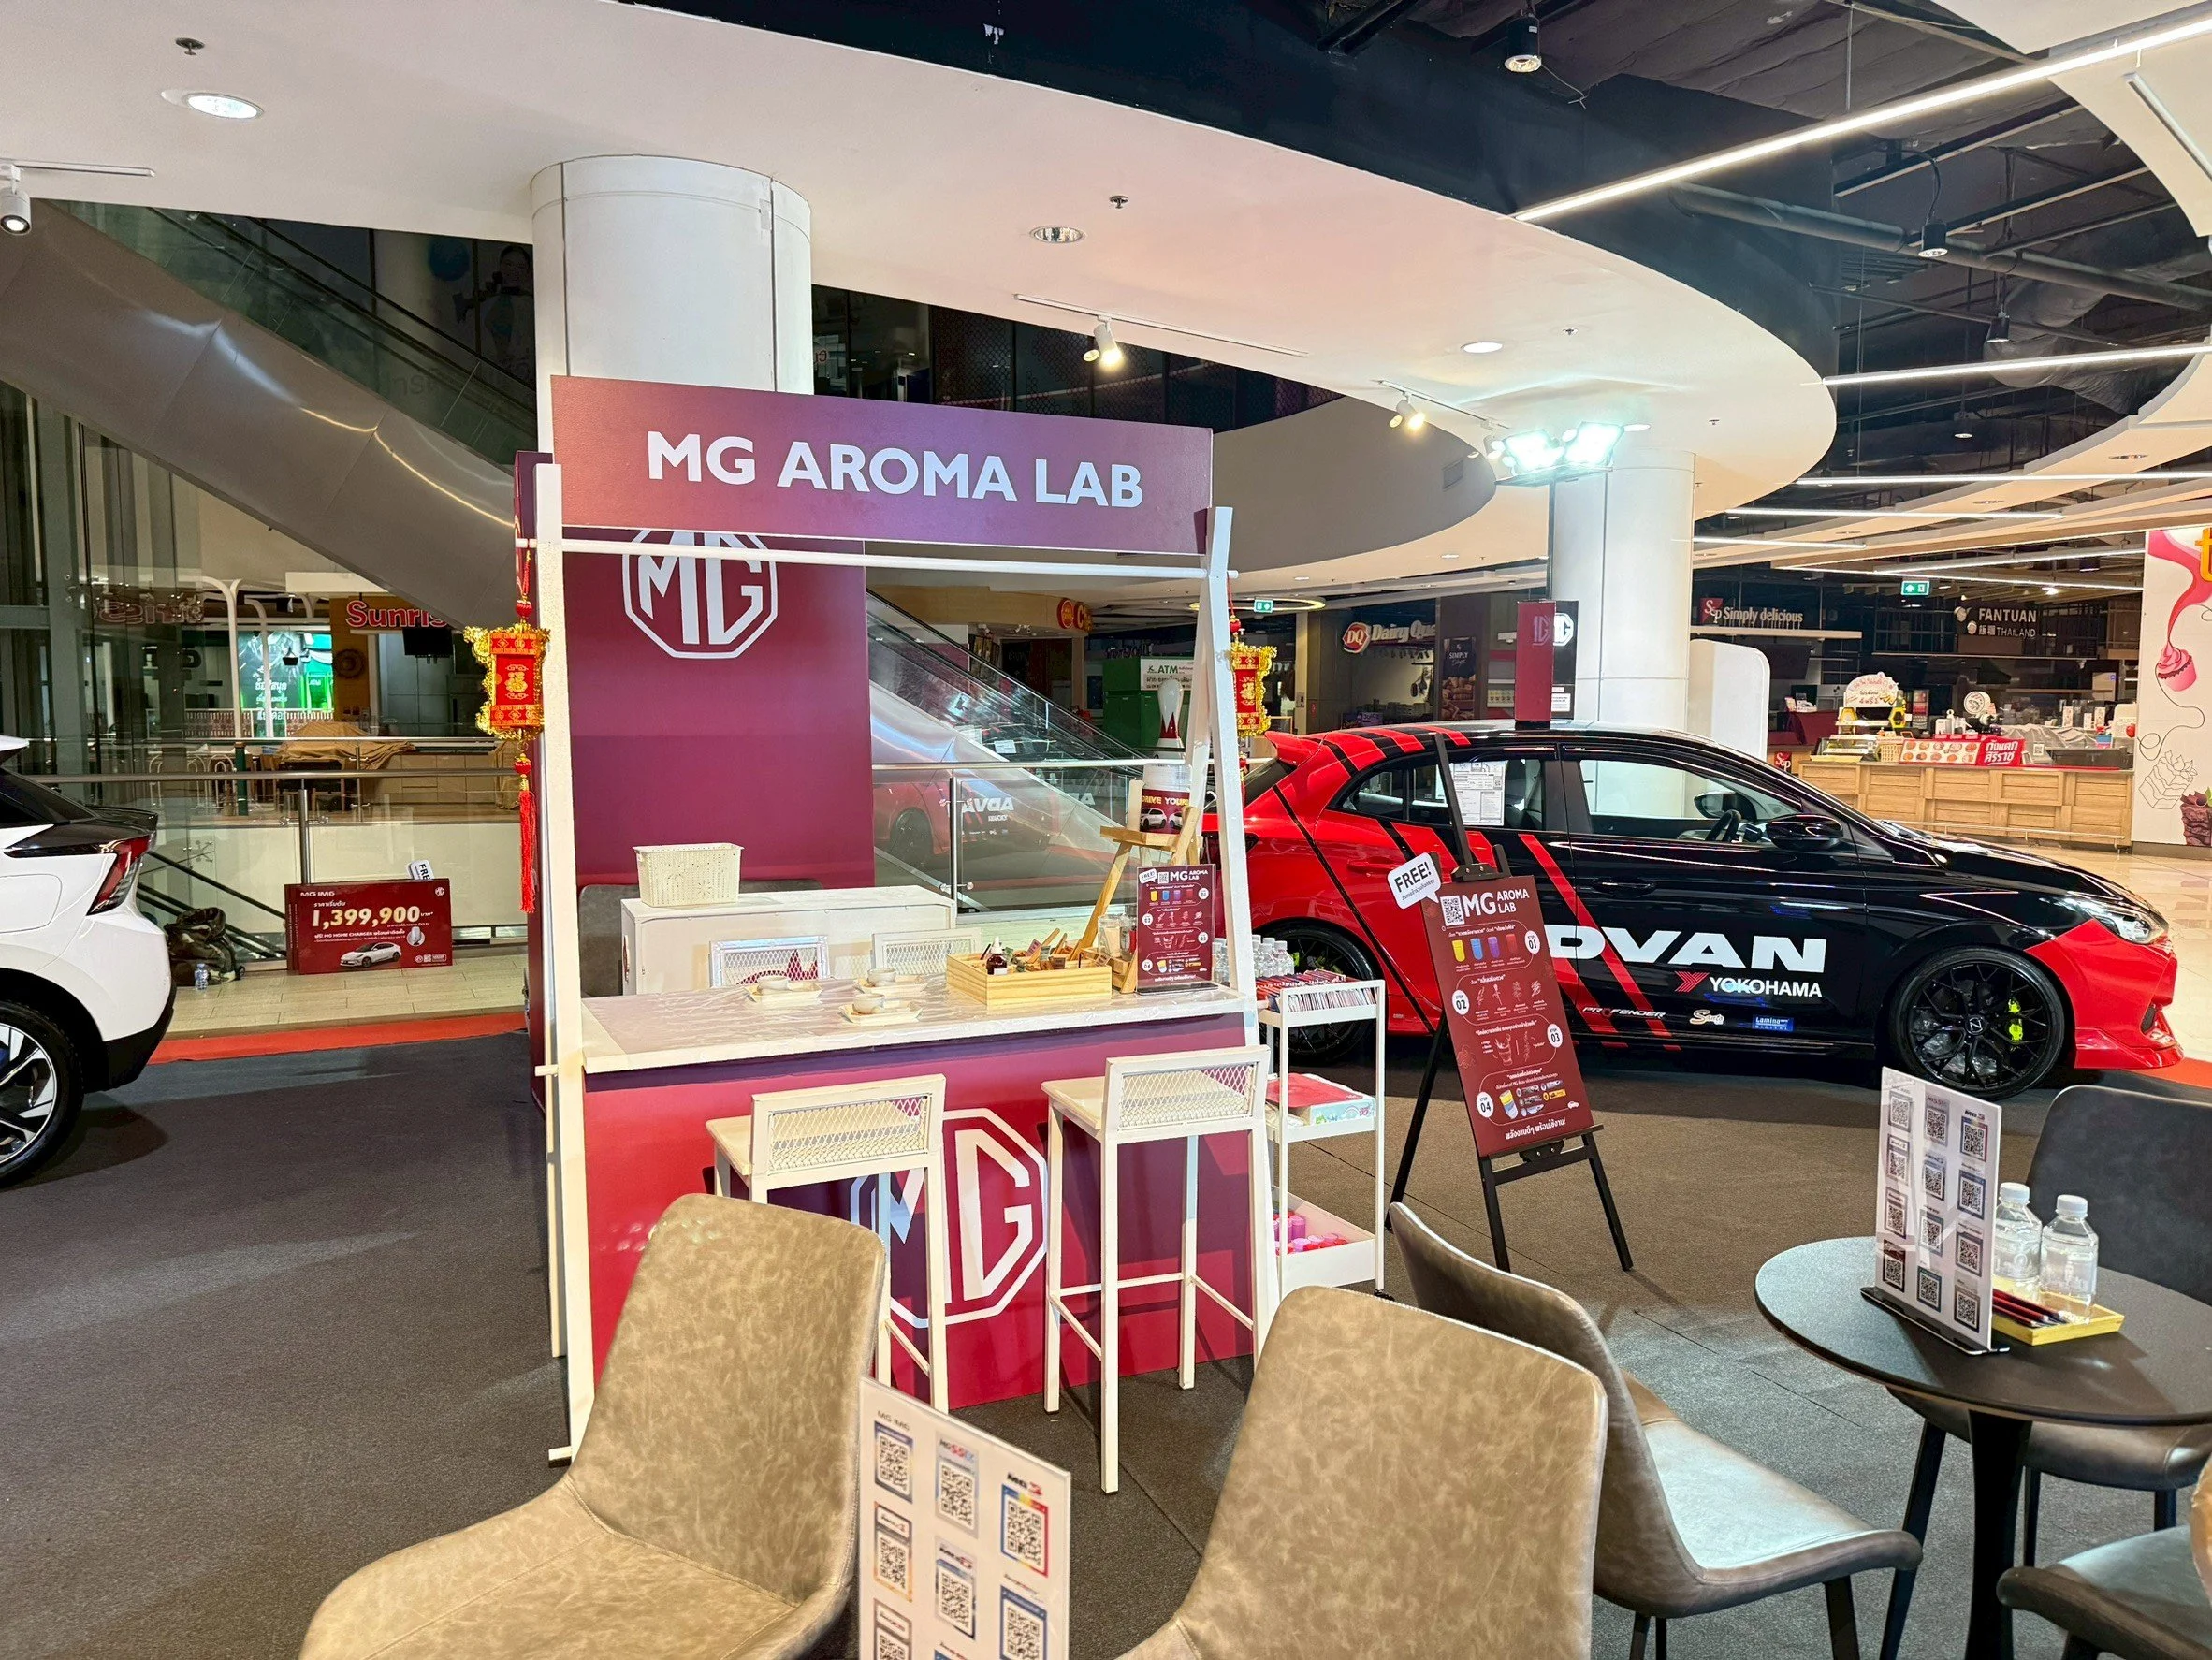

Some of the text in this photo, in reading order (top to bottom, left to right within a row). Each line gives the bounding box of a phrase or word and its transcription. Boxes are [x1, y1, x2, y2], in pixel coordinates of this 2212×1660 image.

[648, 430, 1145, 510] MG AROMA LAB
[1723, 606, 1758, 624] Simply
[1760, 606, 1803, 623] delicious
[1977, 607, 2037, 624] FANTUAN
[1346, 630, 1365, 645] DQ
[1371, 623, 1410, 643] Dairy
[1996, 626, 2036, 638] THAILAND
[1157, 665, 1179, 675] ATM
[1984, 751, 2016, 764] ศิริราช
[1170, 871, 1188, 881] MG
[1394, 861, 1433, 893] FREE!
[1462, 888, 1530, 918] MG AROMA
[1498, 902, 1517, 914] LAB
[312, 906, 420, 930] 1,399,900
[1528, 939, 1537, 950] 01
[1544, 924, 1827, 974] DVAN
[1710, 976, 1823, 998] YOKOHAMA
[1456, 999, 1467, 1010] 02
[1582, 1006, 1666, 1020] PROFENDER
[1550, 1033, 1560, 1042] 03
[1480, 1102, 1492, 1113] 04
[1505, 1116, 1566, 1140] พลังงานดีๆ พร้อมใช้งาน!
